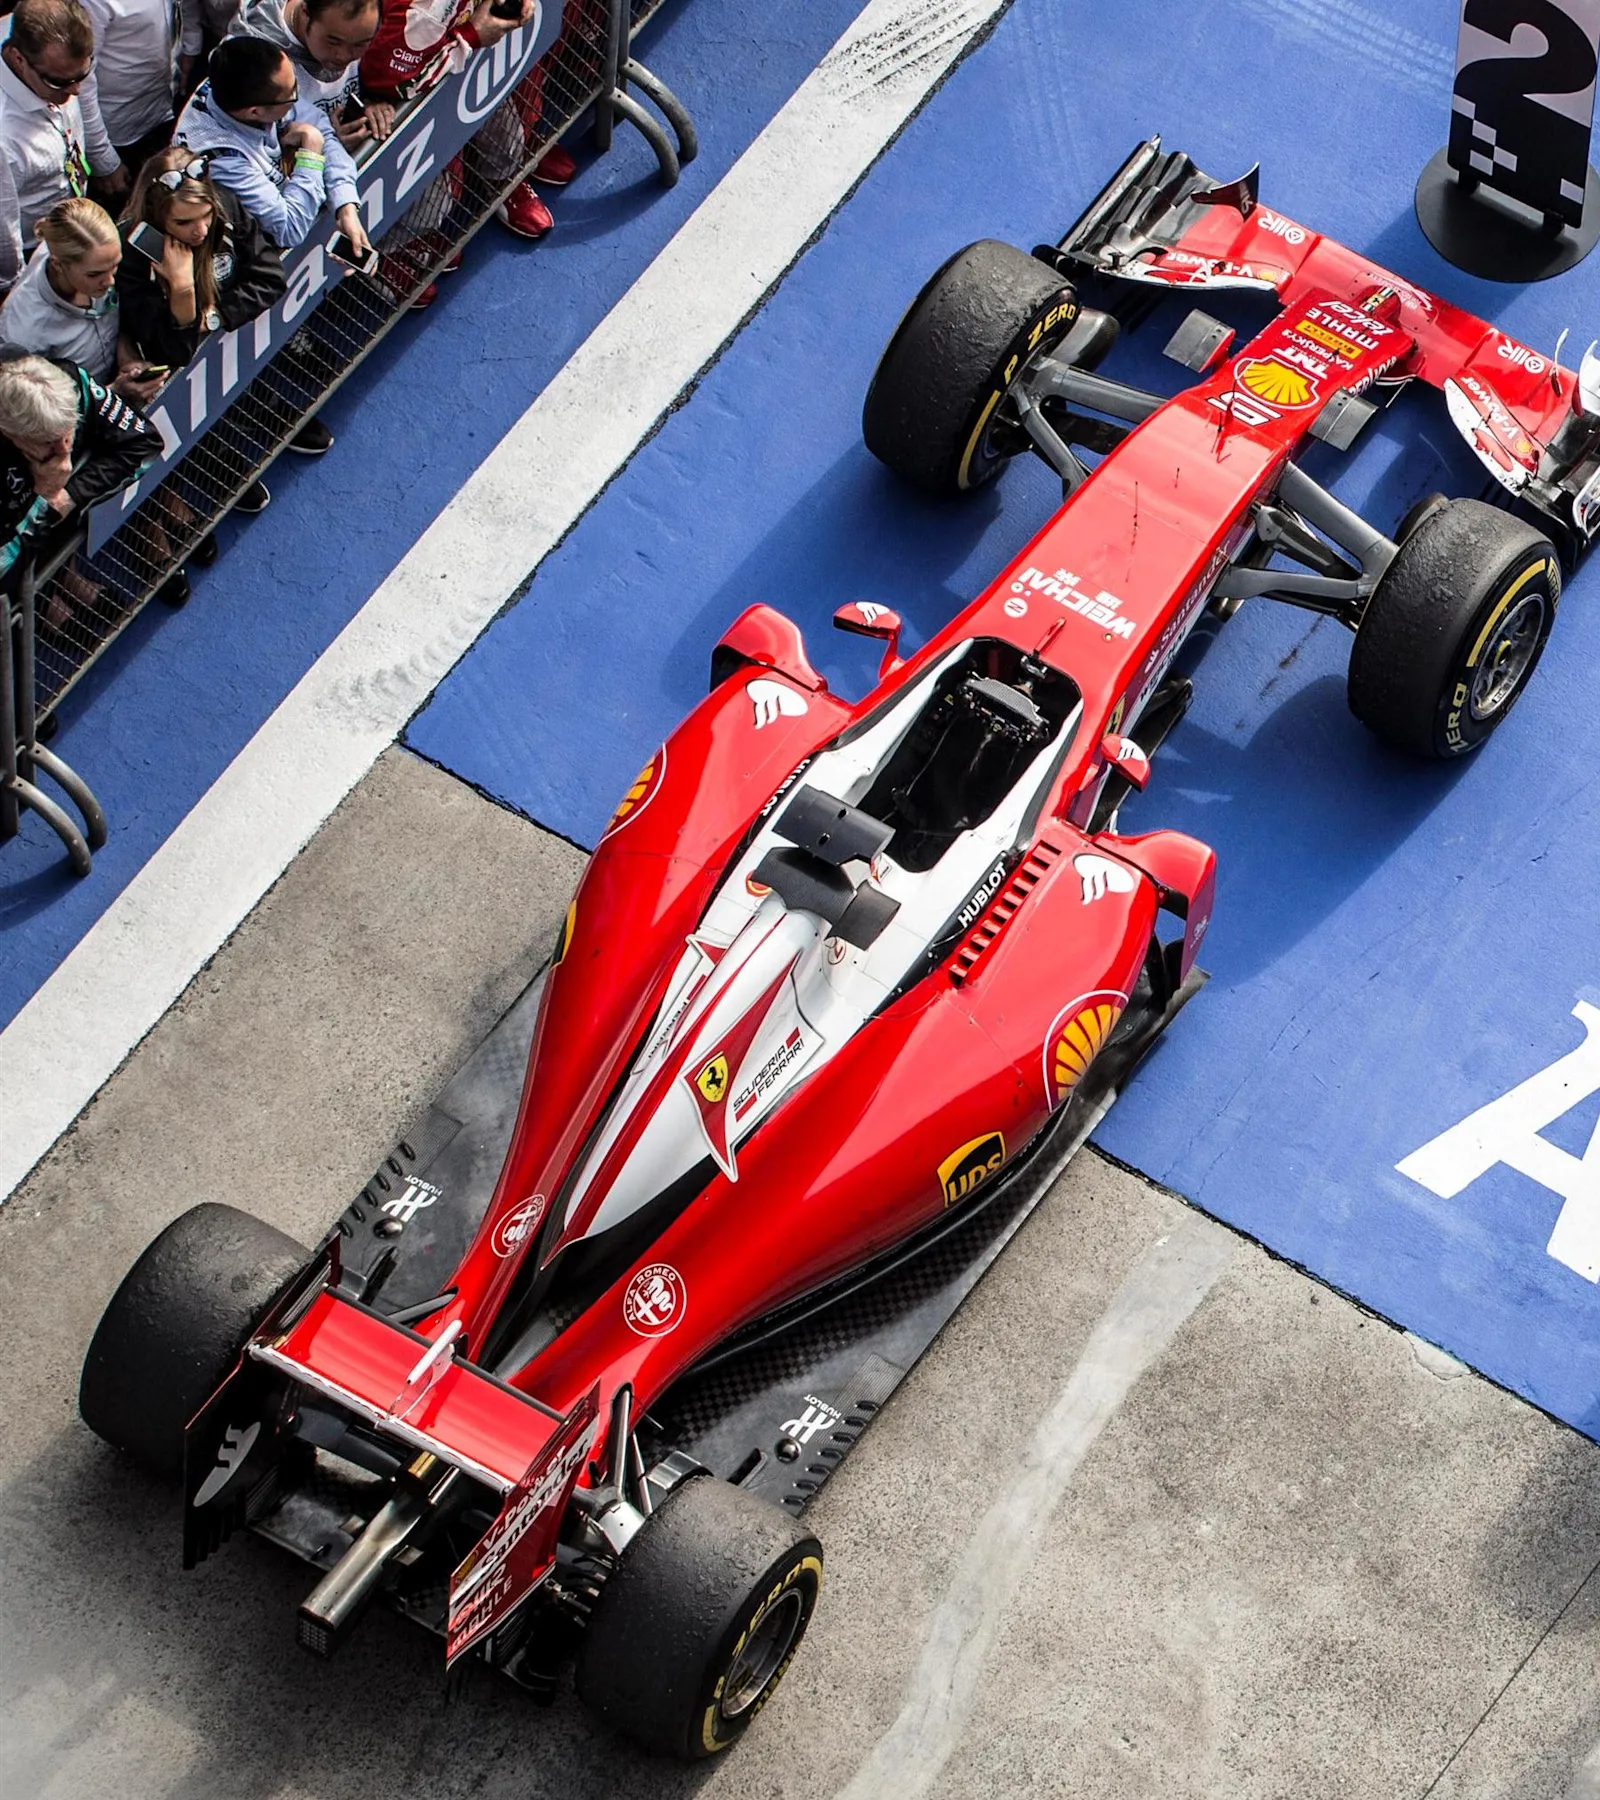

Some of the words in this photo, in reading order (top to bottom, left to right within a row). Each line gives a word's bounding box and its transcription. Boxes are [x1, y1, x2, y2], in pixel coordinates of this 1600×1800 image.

[393, 48, 423, 64] Claro
[1453, 0, 1597, 140] 2
[1003, 354, 1018, 385] P
[1027, 302, 1078, 352] ZERO
[1305, 307, 1379, 350] MAHLE
[1318, 301, 1394, 337] telcel
[1273, 346, 1328, 379] TNT
[1207, 390, 1283, 427] 5
[1460, 375, 1519, 439] V-Power
[1018, 567, 1136, 639] WEICHAI
[957, 861, 1007, 929] HUBLOT
[733, 1044, 788, 1111] SCUDERIA
[757, 1038, 805, 1098] FERRARI
[404, 1174, 443, 1196] HUBLOT
[627, 1289, 636, 1320] ALFA
[636, 1267, 676, 1284] ROMEO
[803, 1394, 842, 1418] HUBLOT
[483, 1444, 567, 1550] V-Power
[484, 1438, 588, 1568] Santander
[452, 1574, 513, 1651] MAHLE
[713, 1675, 724, 1699] P
[732, 1562, 801, 1656] ZERO
